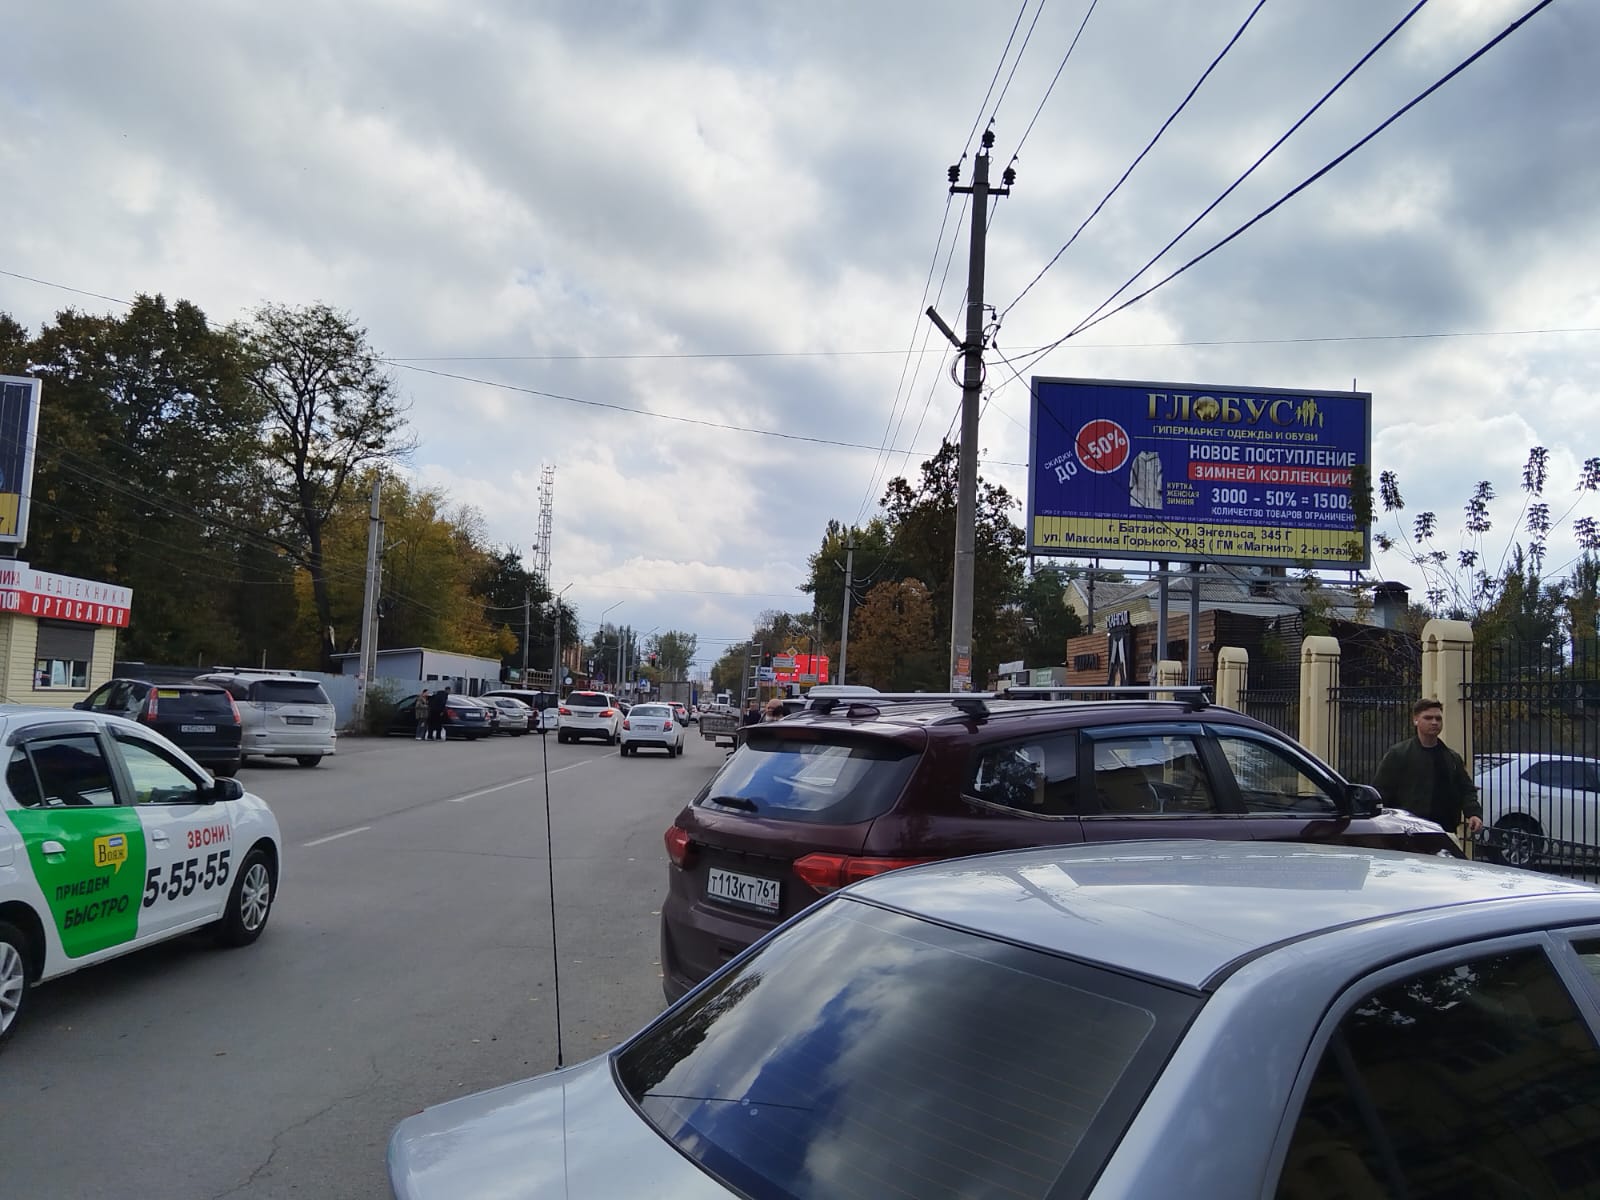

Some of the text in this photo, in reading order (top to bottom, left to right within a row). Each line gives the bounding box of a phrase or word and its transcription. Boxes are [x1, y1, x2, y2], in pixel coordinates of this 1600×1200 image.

[1145, 393, 1296, 426] ГЛОБУС
[1152, 425, 1318, 442] ГИПЕРМАРКЕТ ОДЕЖДЫ И ОБУВИ
[1083, 429, 1126, 460] -50%
[1044, 450, 1073, 469] СКИДКИ
[1189, 444, 1357, 467] НОВОЕ ПОСТУПЛЕНИЕ
[1054, 461, 1078, 484] ДО
[1195, 465, 1256, 481] ЗИМНЕЙ
[1166, 482, 1193, 490] КУРТКА
[1166, 490, 1200, 499] ЖЕНСКАЯ
[1211, 488, 1247, 505] 3000
[1266, 490, 1297, 507] 50%
[1211, 507, 1264, 518] КОЛИЧЕСТВО
[1265, 508, 1302, 519] ТОВАРОВ
[1043, 533, 1061, 544] ул.
[1065, 532, 1120, 545] Максима
[1123, 535, 1181, 549] Горького,
[1175, 527, 1193, 538] ул.
[1197, 527, 1257, 541] Энгельса,
[1261, 530, 1282, 541] 345
[1285, 530, 1293, 541] Г
[34, 575, 126, 603] МЕДТЕХНИКА
[31, 595, 124, 625] ОРТОСАЛОН
[56, 875, 110, 901] ПРИЕДЕМ
[64, 894, 129, 930] БЫСТРО
